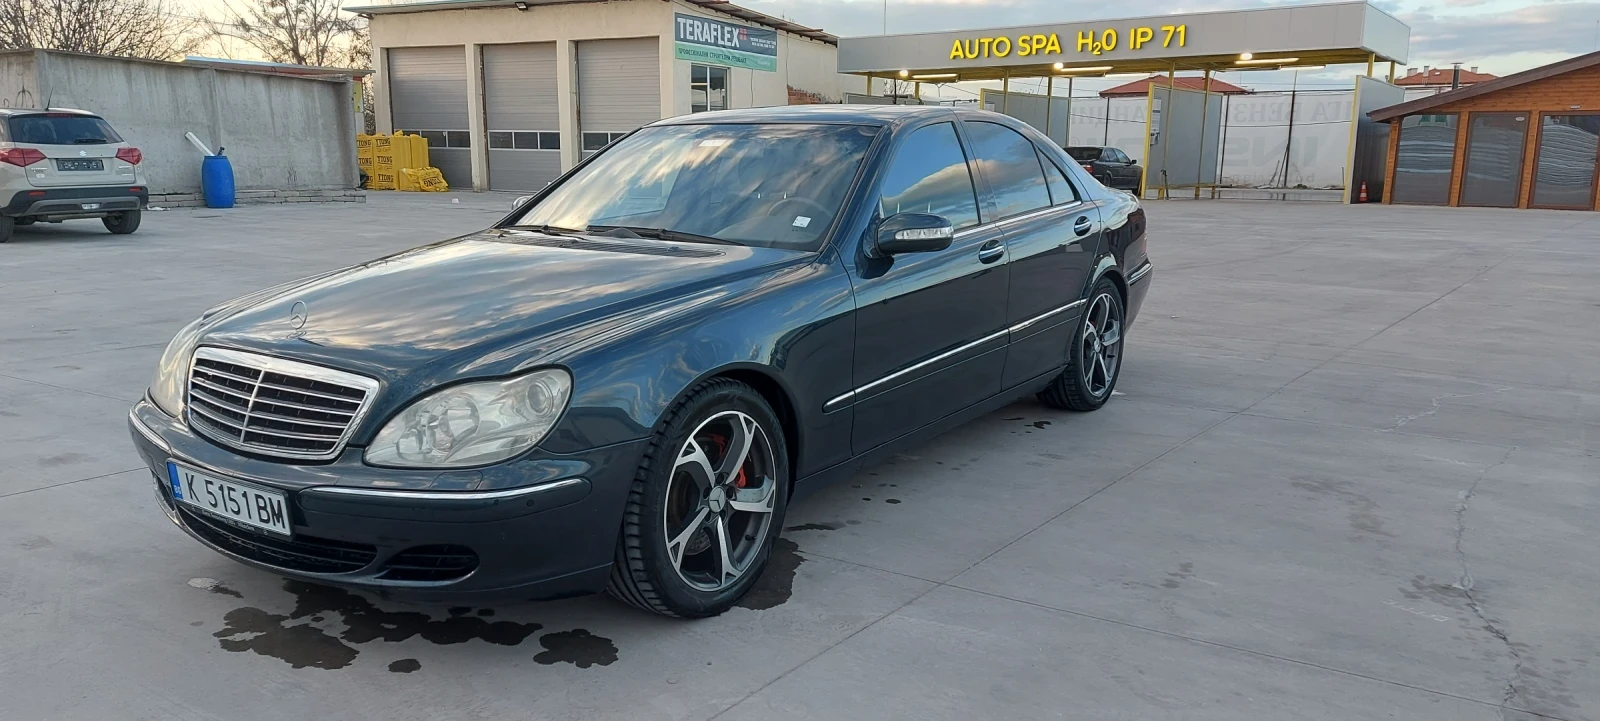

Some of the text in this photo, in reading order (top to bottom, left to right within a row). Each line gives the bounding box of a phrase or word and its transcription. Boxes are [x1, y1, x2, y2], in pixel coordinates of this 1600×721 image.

[677, 18, 739, 48] TERAFLEX
[950, 36, 1011, 60] AUTO
[1017, 33, 1061, 56] SPA
[1130, 27, 1153, 50] IP
[1161, 24, 1186, 48] 71
[185, 472, 200, 502] K
[204, 479, 252, 519] 5151
[254, 493, 286, 529] BM
